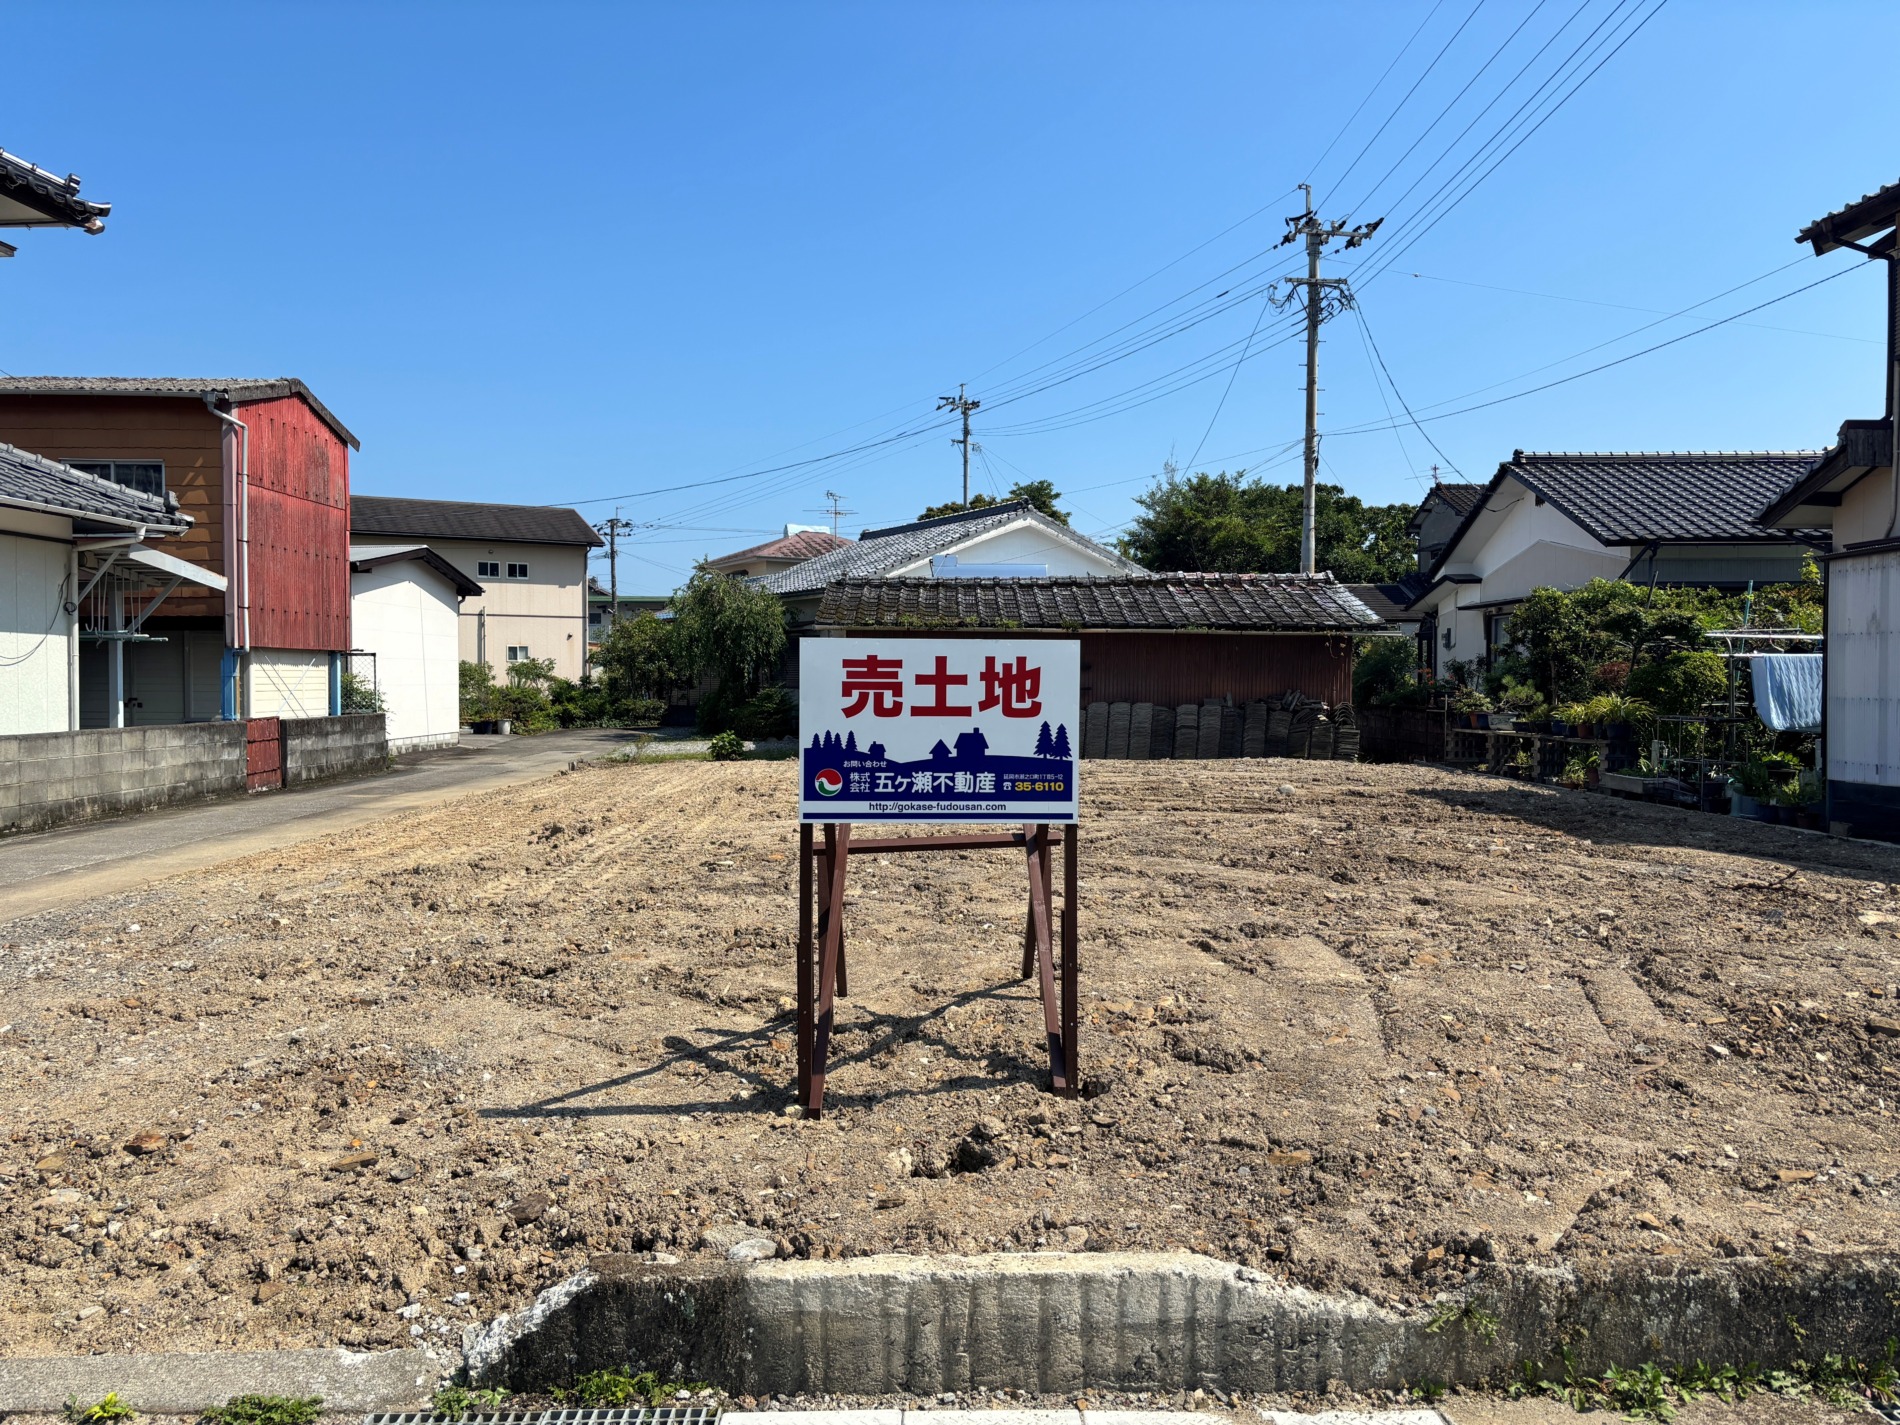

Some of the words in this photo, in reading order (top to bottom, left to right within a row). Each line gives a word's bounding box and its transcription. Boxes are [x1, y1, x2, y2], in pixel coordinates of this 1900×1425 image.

[841, 654, 1042, 719] 売土地
[843, 760, 887, 768] お問い合わせ
[849, 771, 871, 782] 株式
[849, 782, 871, 793] 会社
[869, 802, 1007, 813] http://gokase-fudousan.com
